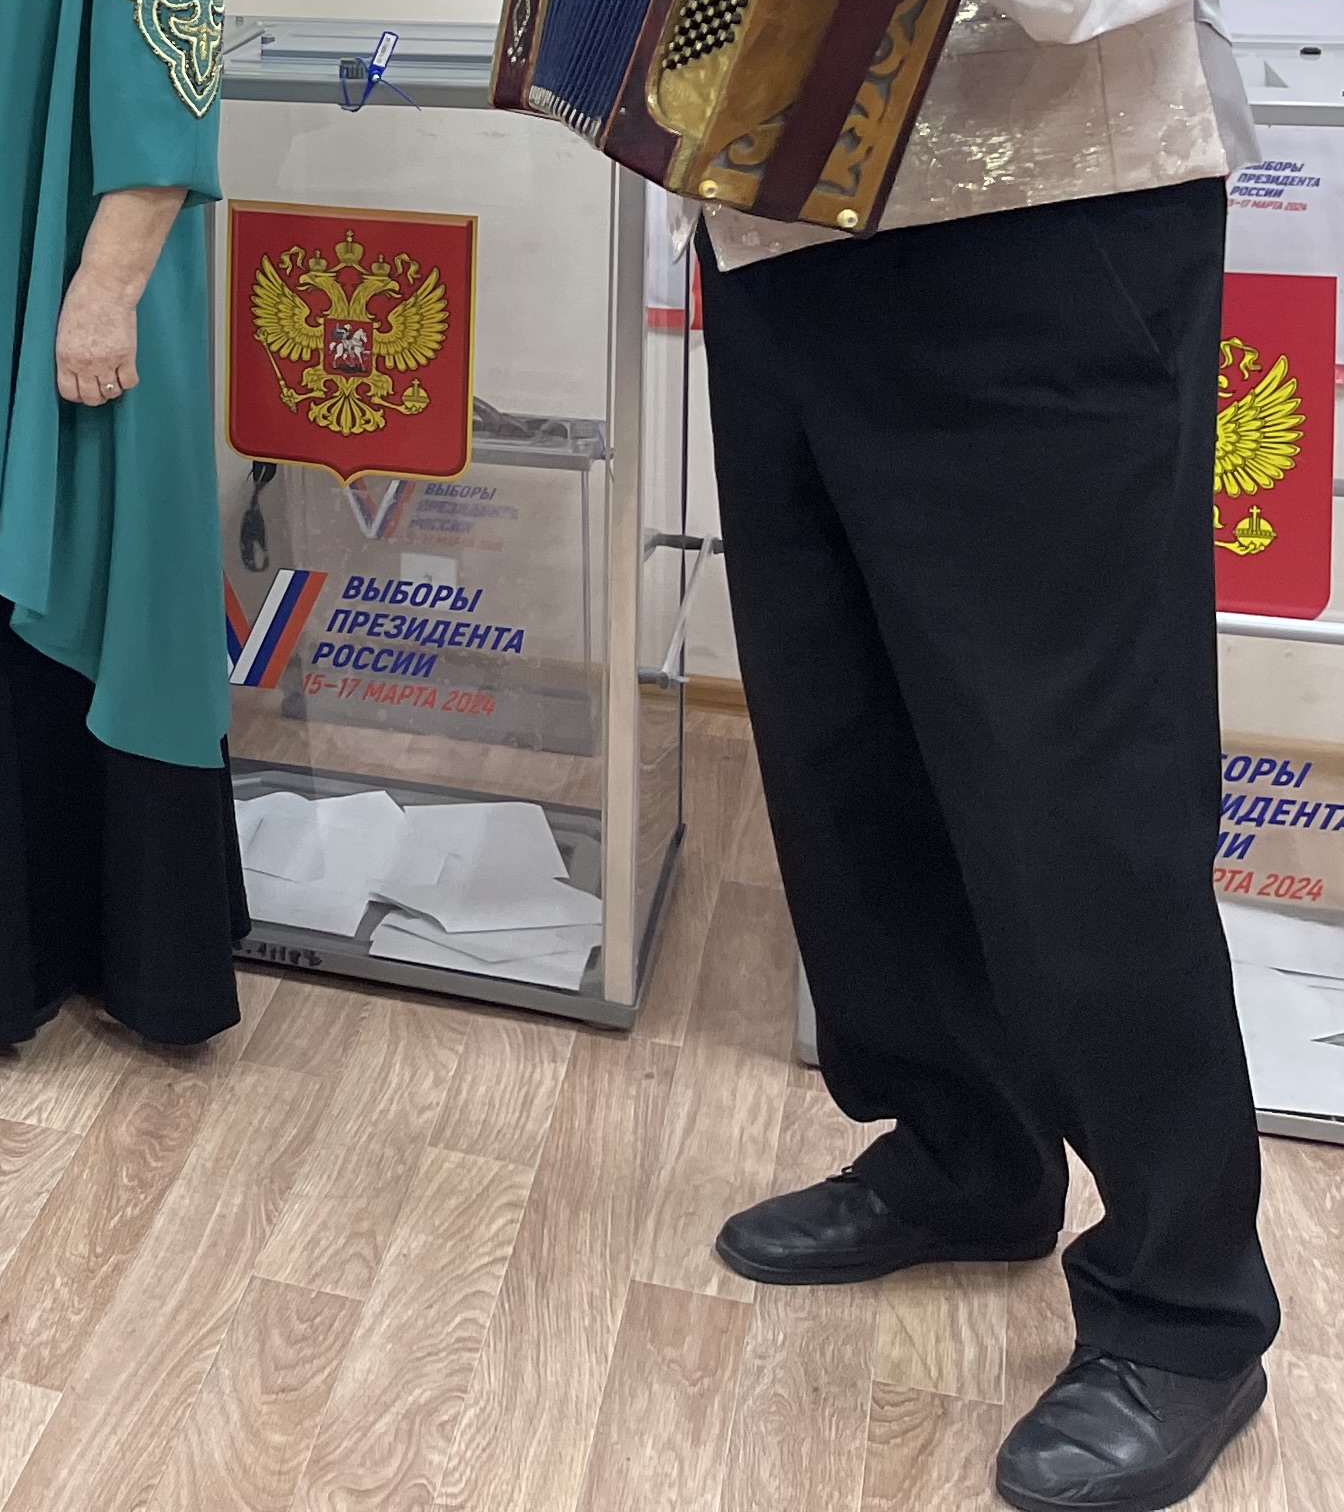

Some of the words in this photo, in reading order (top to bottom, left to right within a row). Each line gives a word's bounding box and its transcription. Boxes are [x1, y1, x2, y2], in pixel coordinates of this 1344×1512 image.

[1237, 173, 1321, 187] ПРЕЗИДЕНТА
[1245, 161, 1304, 173] ЫБОРЫ
[1229, 186, 1284, 198] РОССИИ
[425, 482, 497, 500] ВЫБОРЫ
[342, 575, 483, 612] ВЫБОРЫ
[326, 609, 525, 653] ПРЕЗИДЕНТА
[311, 642, 438, 678] РОССИИ
[362, 679, 438, 709] МАРТА
[442, 690, 496, 717] 2024
[1221, 753, 1312, 788] ОРЫ
[1221, 793, 1344, 831] ИДЕНТ
[1213, 868, 1254, 893] РТА
[1256, 873, 1323, 901] 2024
